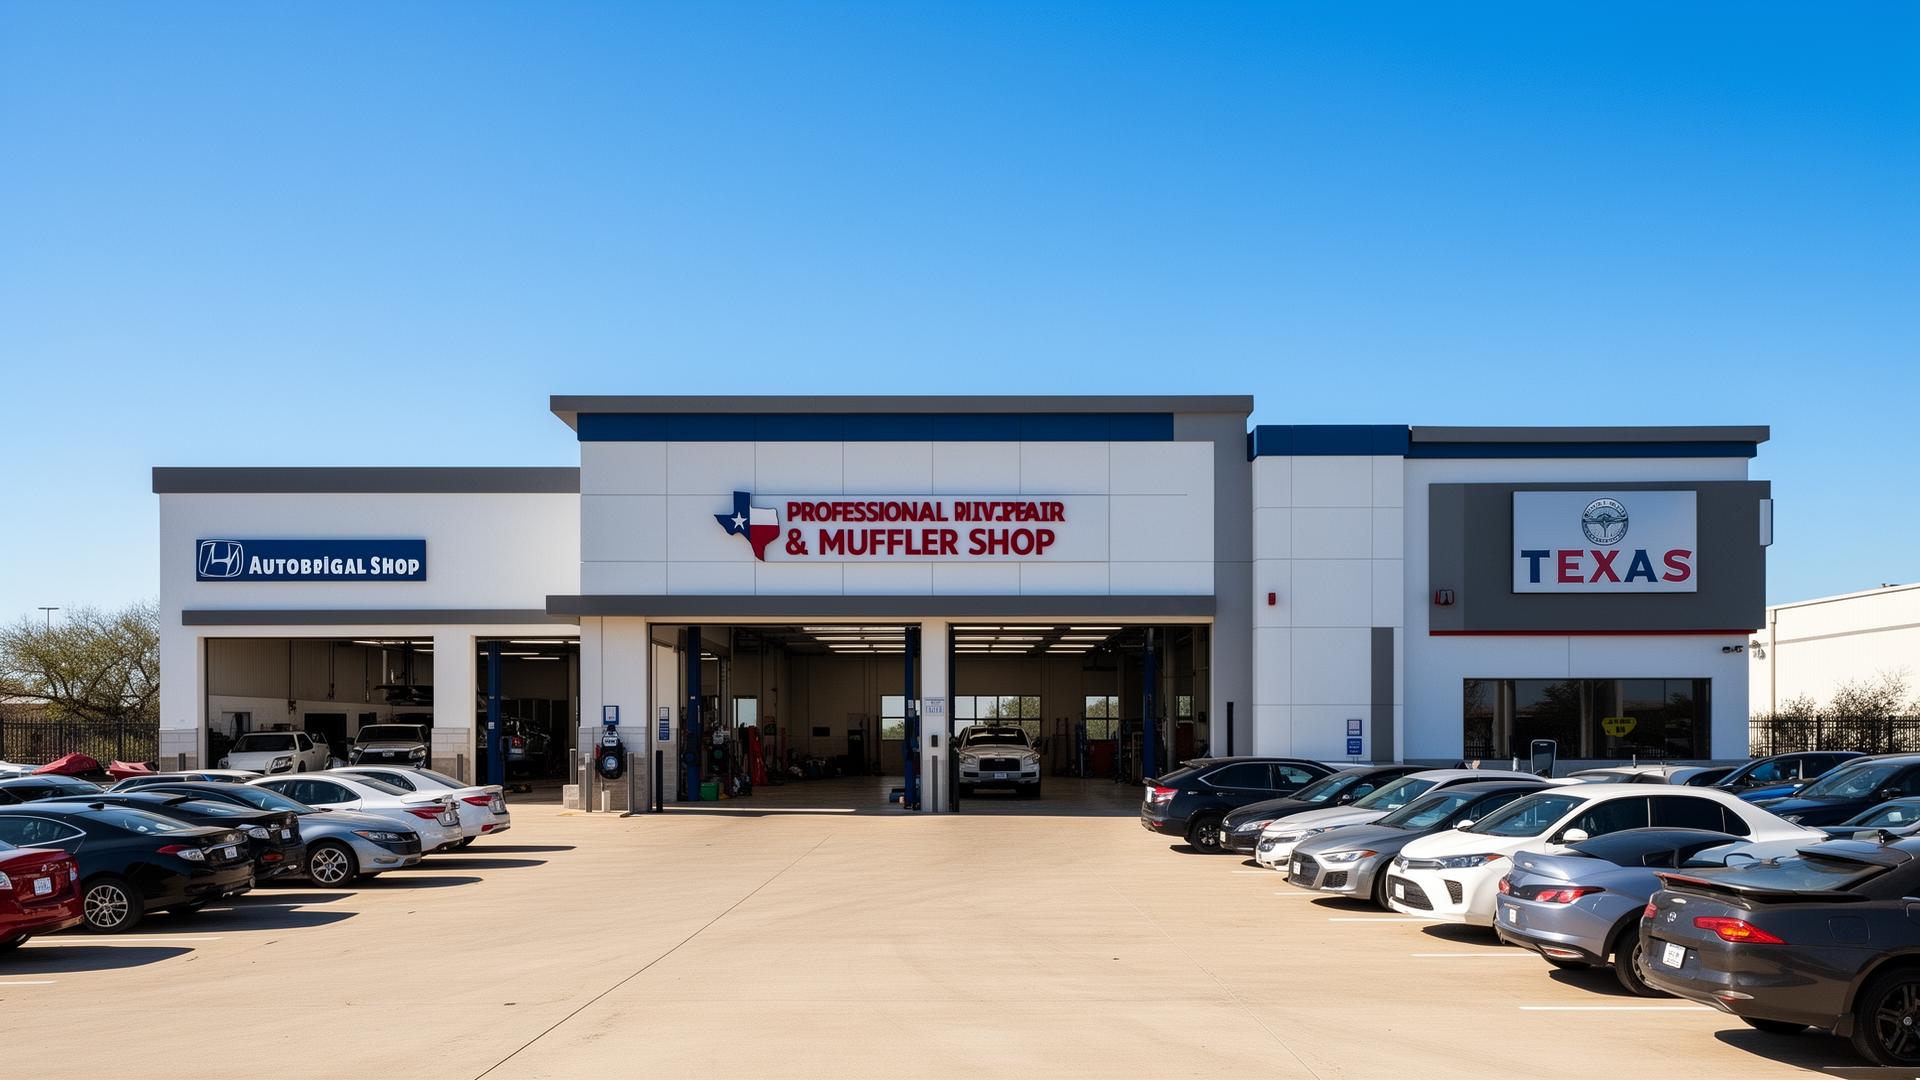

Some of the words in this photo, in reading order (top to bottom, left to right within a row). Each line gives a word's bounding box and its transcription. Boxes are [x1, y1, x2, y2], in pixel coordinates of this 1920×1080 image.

[787, 501, 948, 523] PROFESSIONAL
[785, 528, 808, 556] &
[819, 529, 959, 556] MUFFLER
[968, 528, 1056, 556] SHOP
[370, 556, 420, 576] SHOP
[1520, 548, 1693, 584] TEXAS
